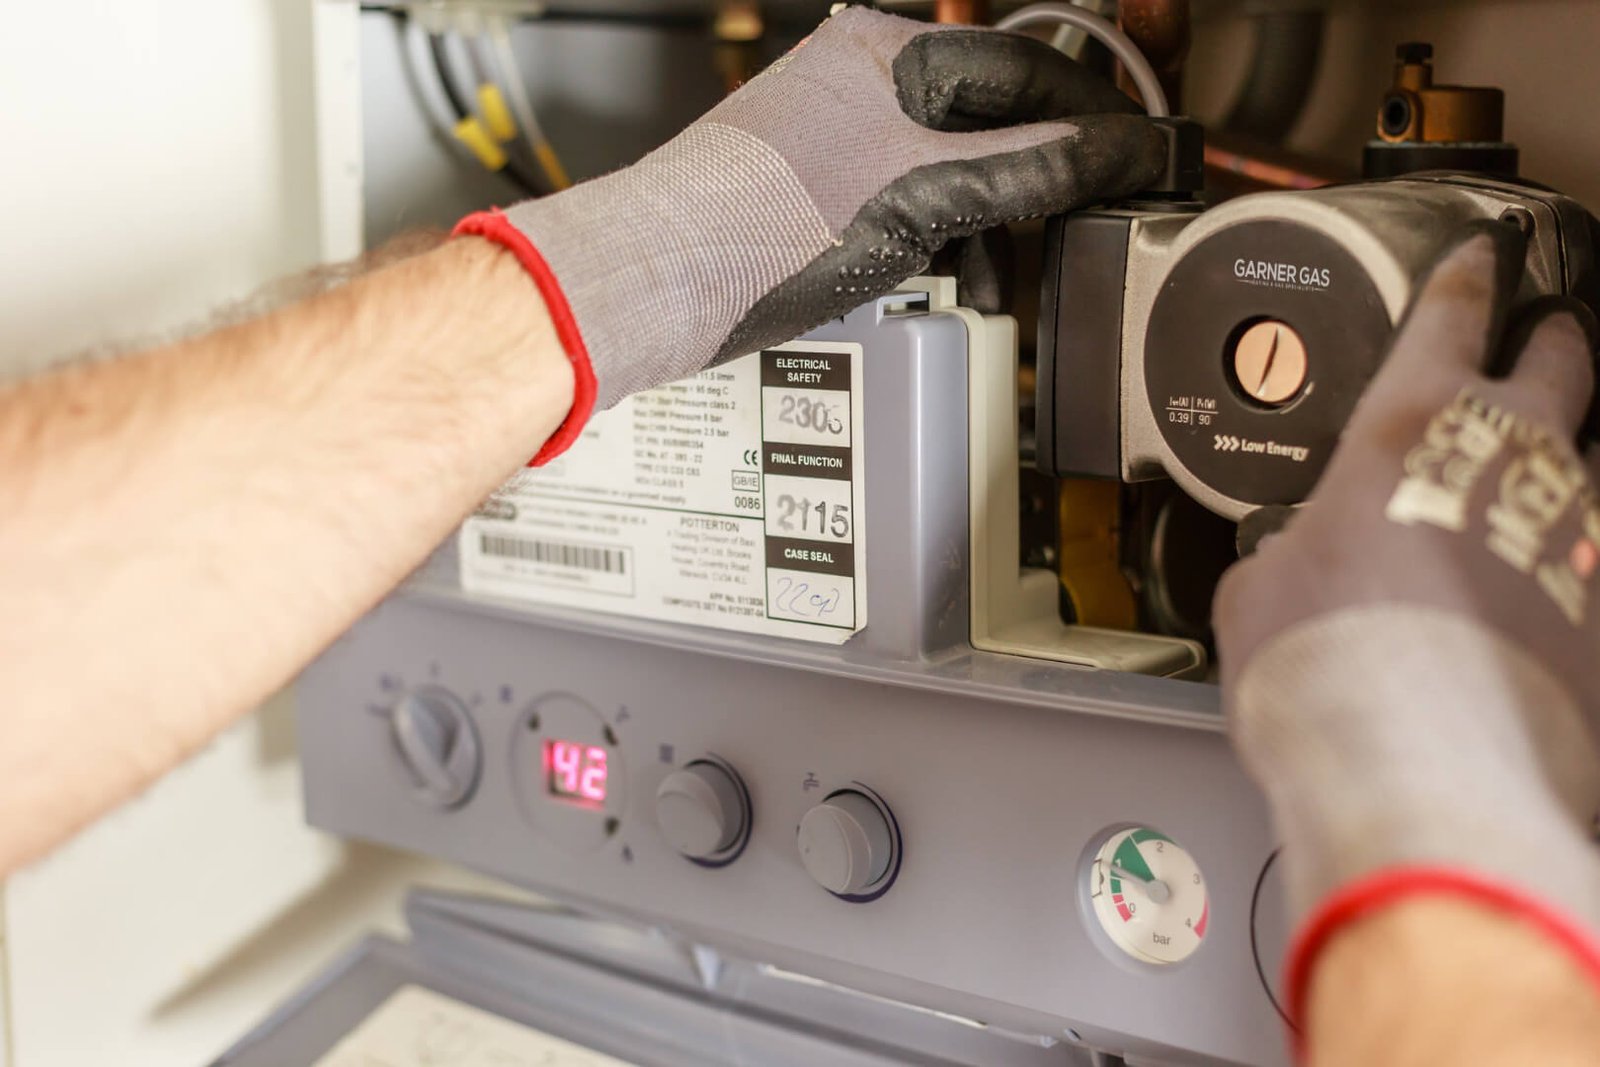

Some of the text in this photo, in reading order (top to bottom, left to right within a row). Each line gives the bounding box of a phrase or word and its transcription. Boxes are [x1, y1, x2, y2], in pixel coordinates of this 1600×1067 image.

[1234, 258, 1331, 287] GARNER GAS
[776, 358, 831, 370] ELECTRICAL
[787, 372, 822, 383] SAFETY
[1168, 412, 1210, 425] 0.39 90
[1241, 438, 1309, 462] Low Energy
[771, 452, 843, 468] FINAL FUNCTION
[734, 496, 760, 509] 0086
[680, 517, 740, 532] POTTERTON
[784, 548, 835, 563] CASE SEAL
[553, 741, 608, 800] 42
[1156, 841, 1164, 853] 2
[1193, 873, 1200, 885] 3
[1129, 902, 1136, 914] 0
[1185, 917, 1192, 928] 4
[1152, 932, 1172, 945] bar
